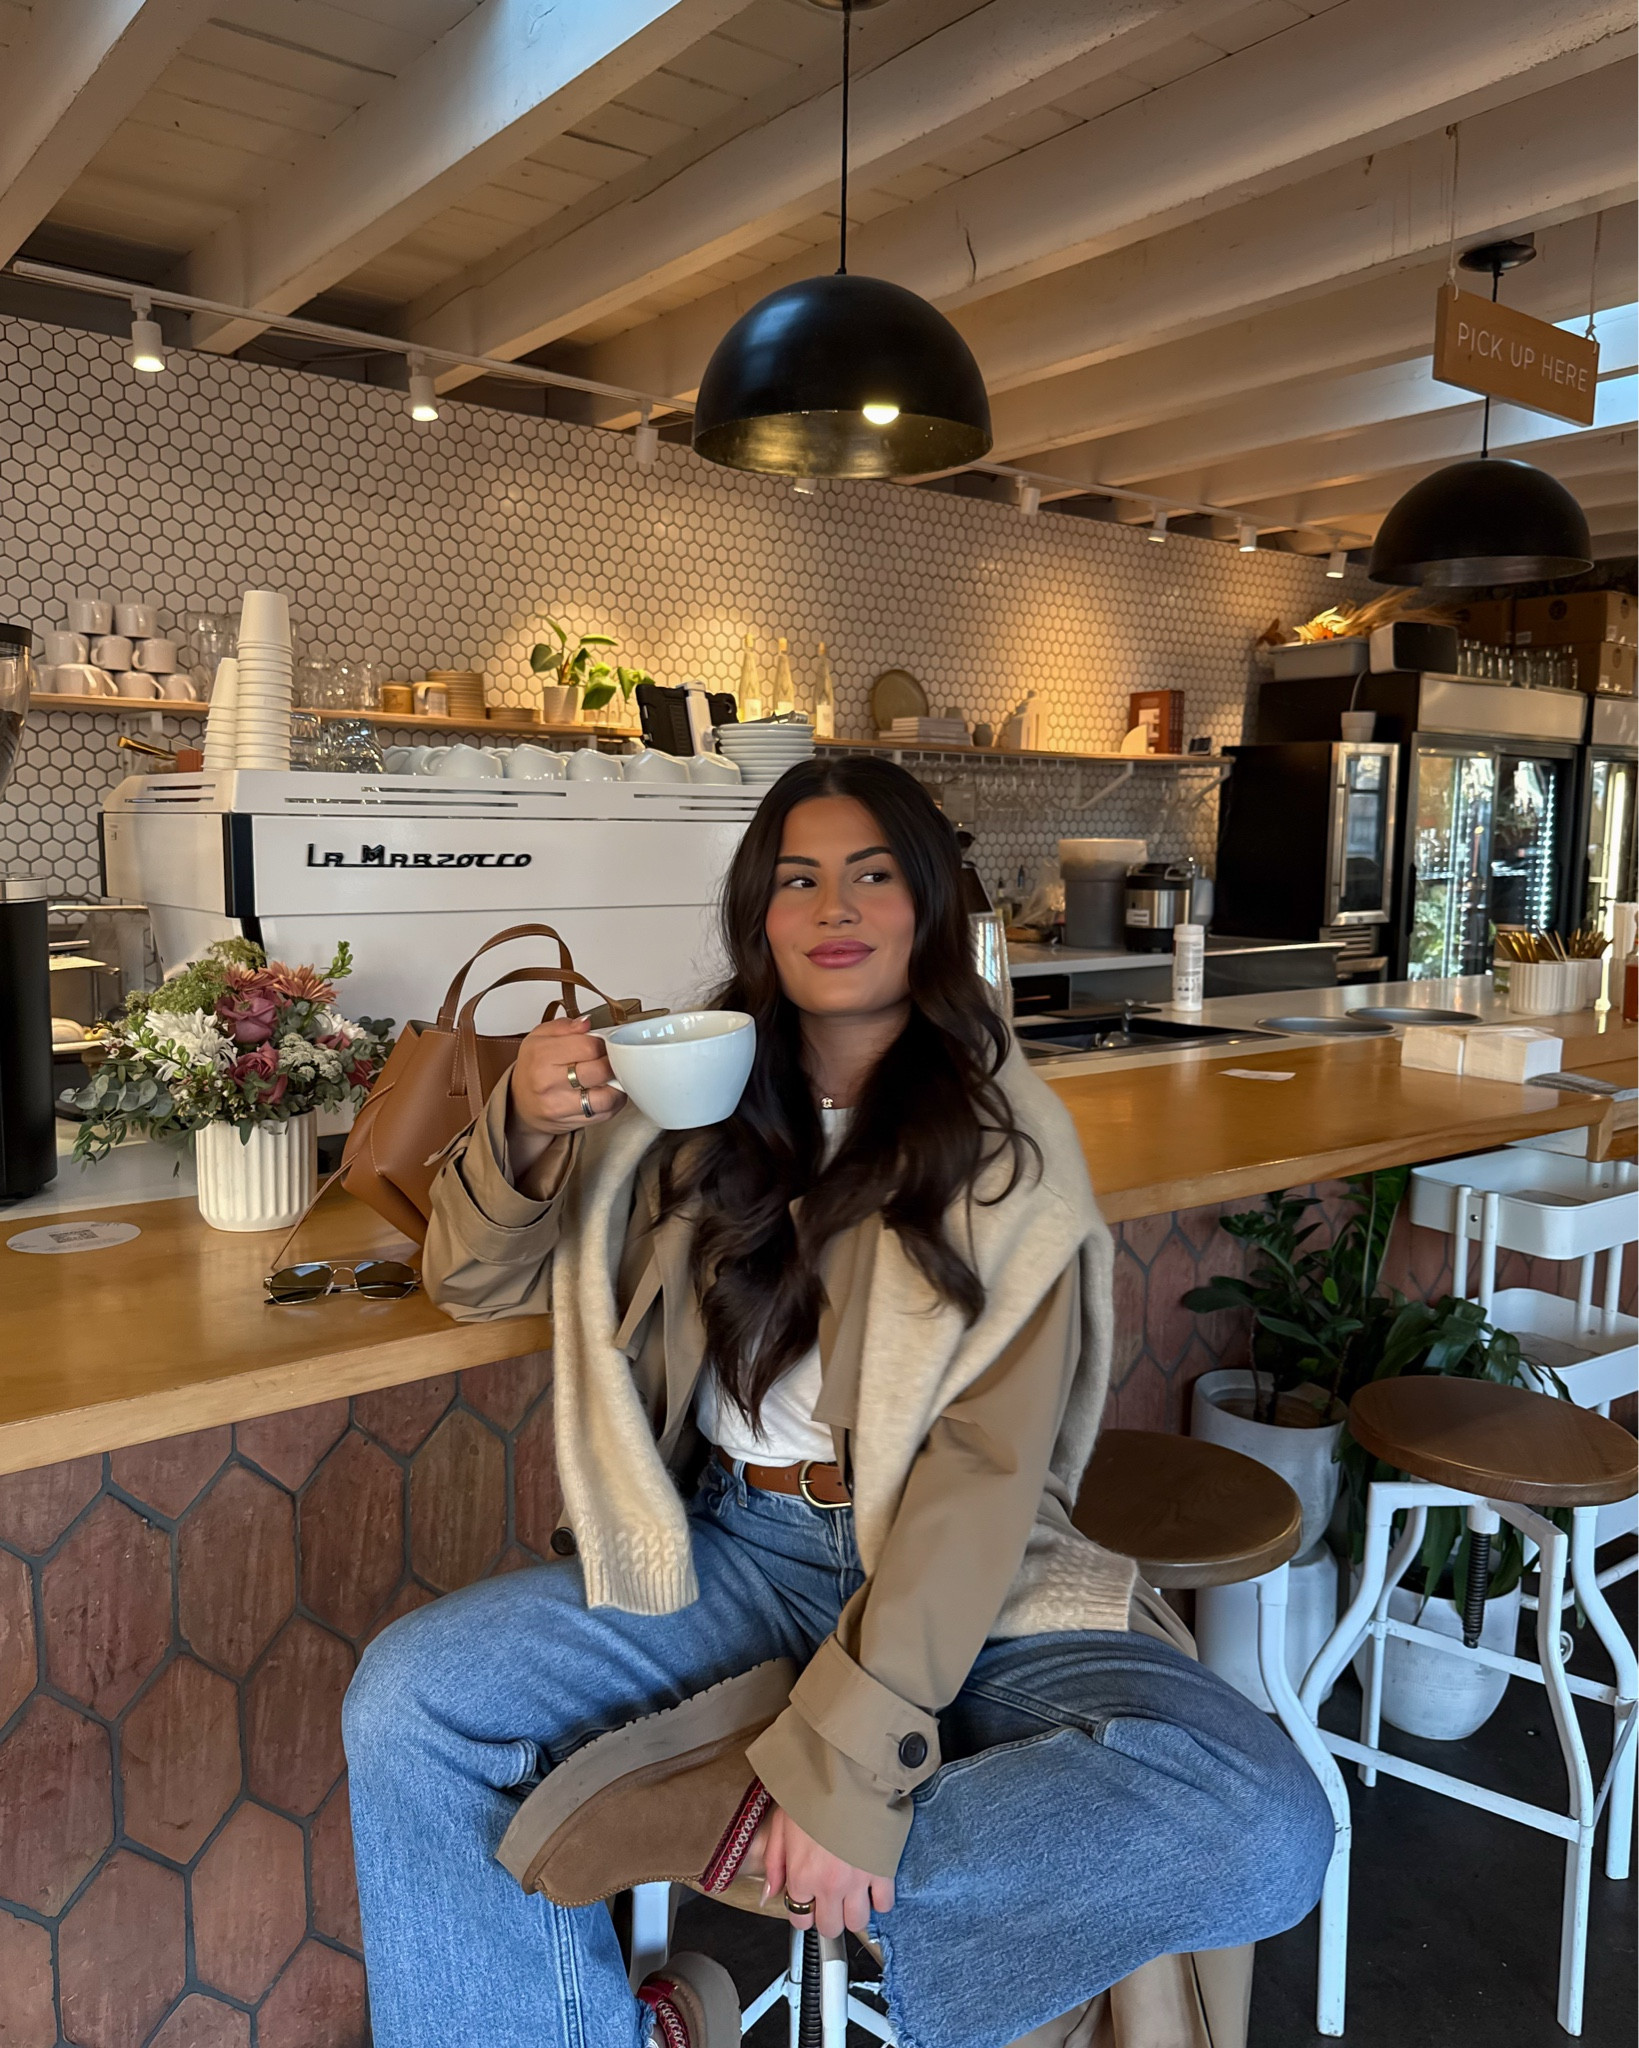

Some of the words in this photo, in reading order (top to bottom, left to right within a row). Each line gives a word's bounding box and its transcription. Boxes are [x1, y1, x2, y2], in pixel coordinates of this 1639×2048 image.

[1457, 322, 1503, 362] PICK
[1510, 342, 1535, 370] UP
[1541, 354, 1589, 393] HERE
